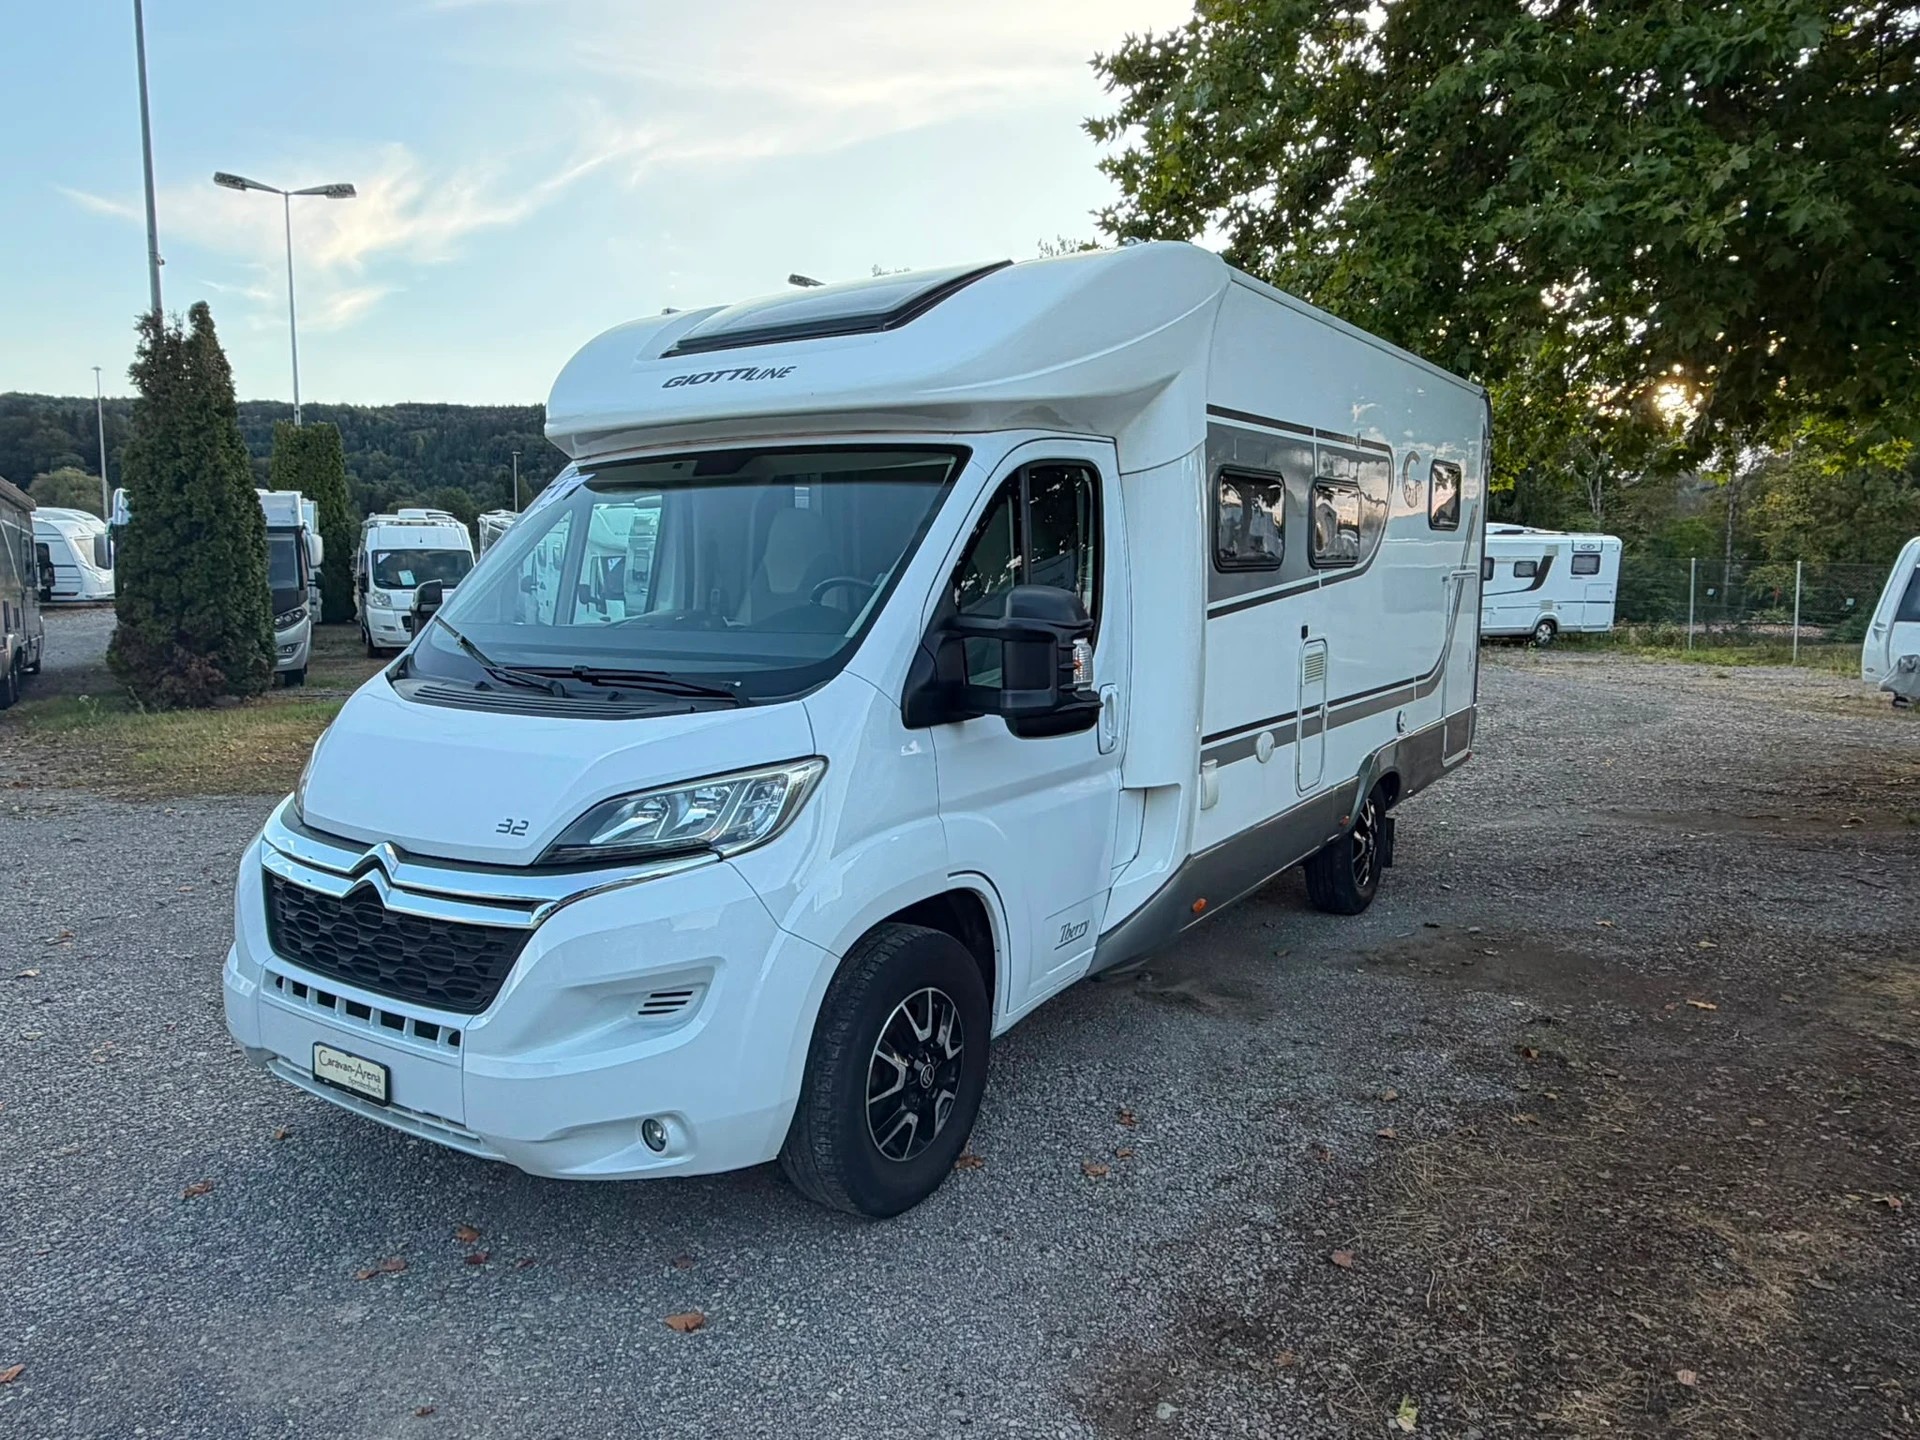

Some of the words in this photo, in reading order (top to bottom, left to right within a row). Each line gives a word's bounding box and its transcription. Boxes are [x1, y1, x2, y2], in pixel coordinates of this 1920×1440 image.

[662, 366, 797, 388] GIOTTILINE
[495, 818, 529, 836] 32
[319, 1050, 381, 1083] Caravan-Arena
